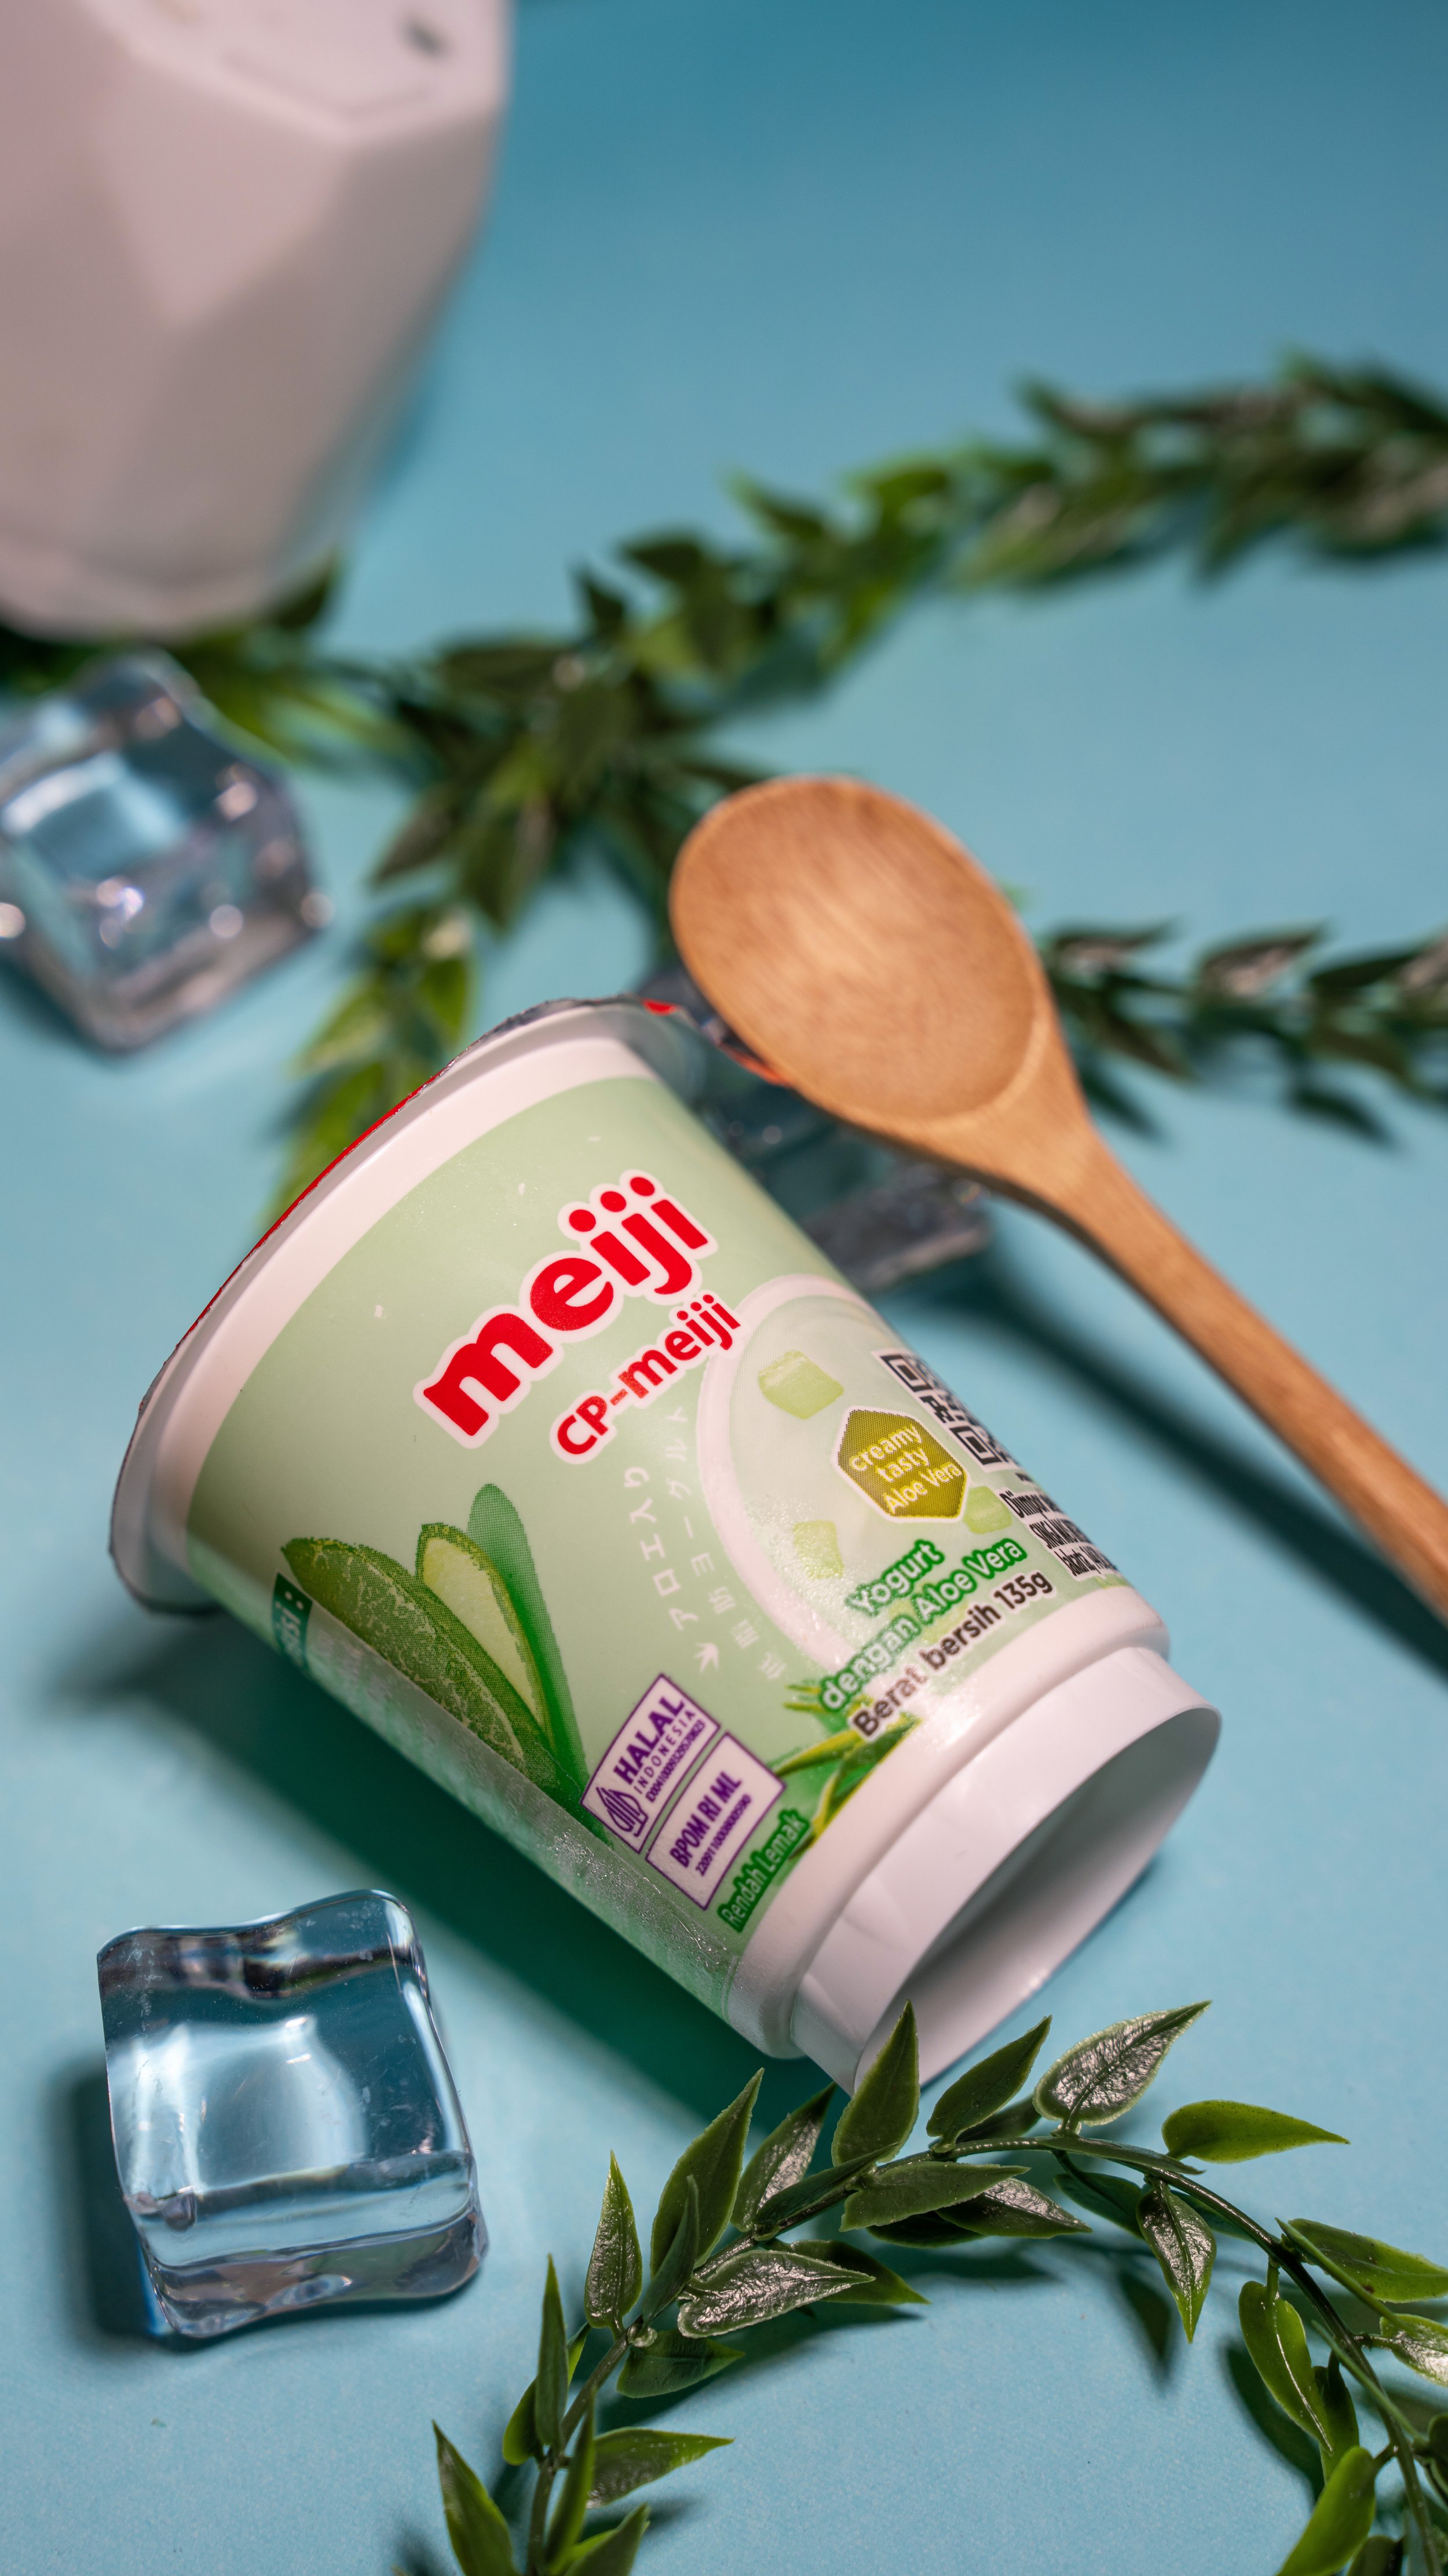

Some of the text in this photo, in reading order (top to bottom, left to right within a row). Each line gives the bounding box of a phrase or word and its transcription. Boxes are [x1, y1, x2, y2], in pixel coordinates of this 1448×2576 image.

[423, 1176, 708, 1436] meiji
[557, 1294, 741, 1455] CP-meiji
[850, 1423, 922, 1471] creamy
[878, 1447, 930, 1482] tasty
[883, 1462, 963, 1514] Aloe Vera
[624, 1467, 699, 1630] アロエ入り
[853, 1544, 940, 1612] Yogurt
[823, 1540, 1022, 1709] dengan Aloe Vera
[853, 1571, 1052, 1736] Berat bersih 135g
[613, 1697, 685, 1785] HALAL
[634, 1710, 696, 1794] INDONESIA
[670, 1771, 742, 1867] BPOM RI ML
[722, 1812, 809, 1928] Rendah Lemak
